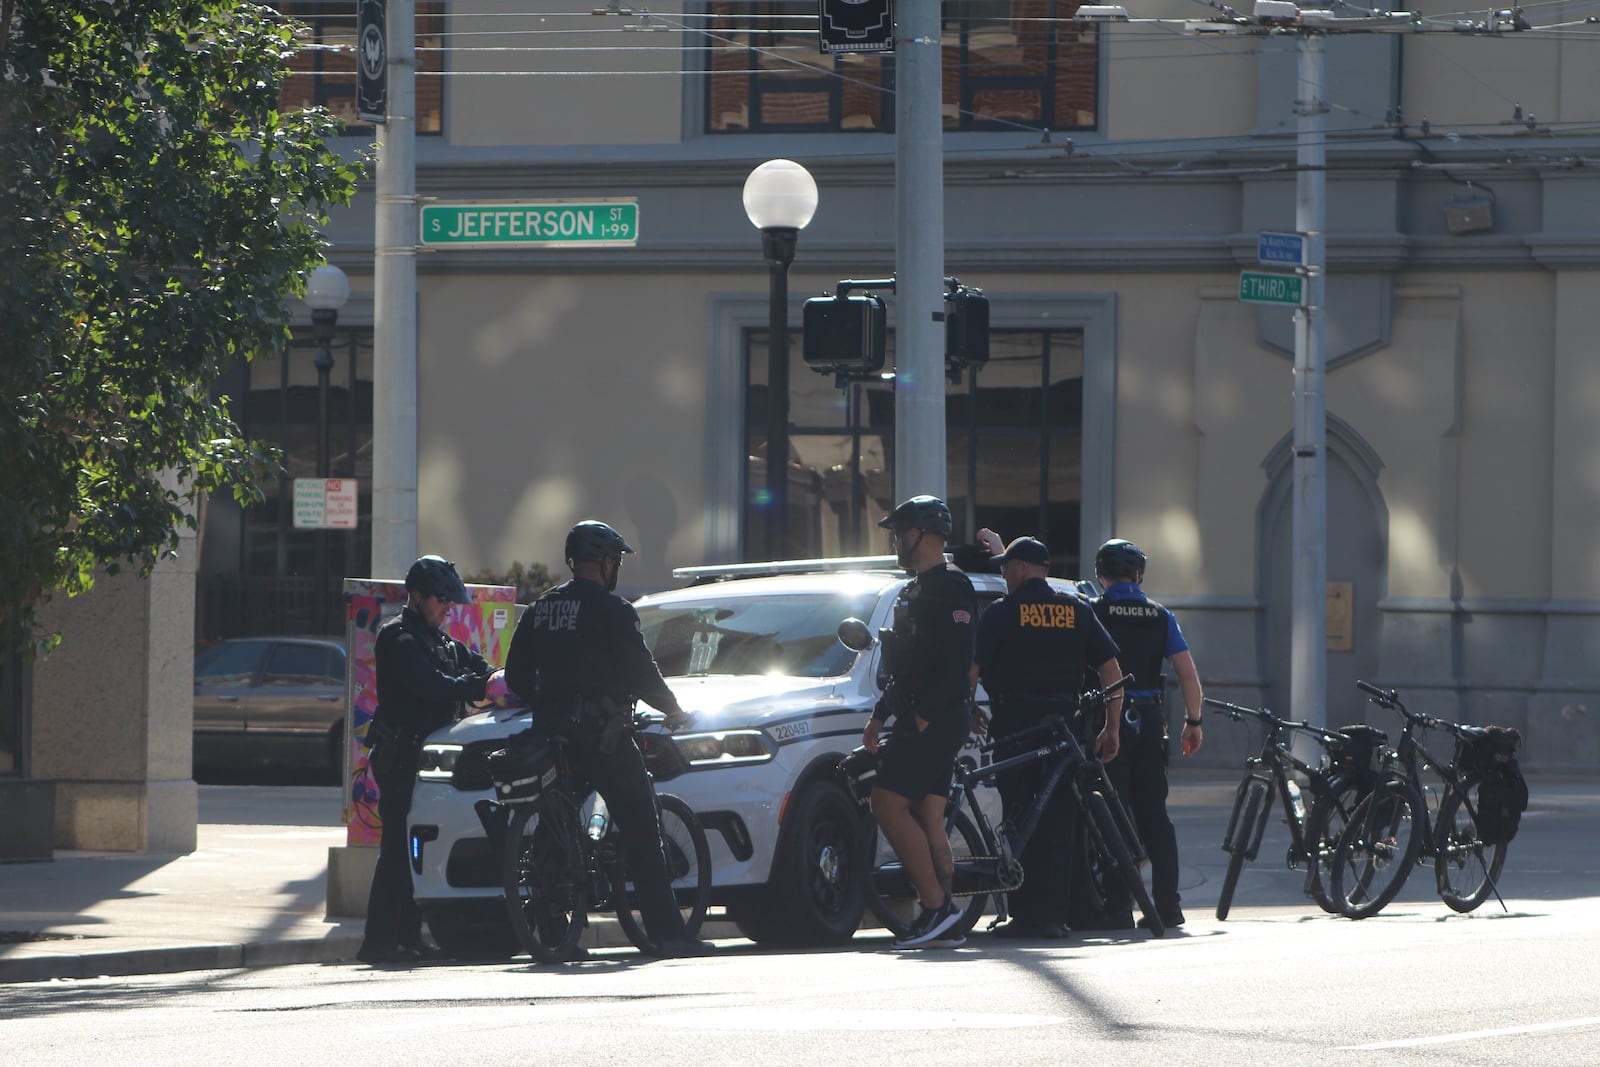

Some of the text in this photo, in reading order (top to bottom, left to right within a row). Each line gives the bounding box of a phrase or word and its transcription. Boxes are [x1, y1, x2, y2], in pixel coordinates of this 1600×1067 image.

[609, 208, 623, 221] ST
[432, 210, 594, 237] S JEFFERSON
[601, 223, 629, 237] 1-99
[1242, 278, 1286, 299] E THIRD
[327, 481, 341, 491] NO
[535, 599, 581, 616] DAYTON
[1020, 603, 1075, 617] DAYTON
[1109, 605, 1143, 616] POLICE
[1020, 614, 1075, 628] POLICE
[775, 721, 810, 740] 220497
